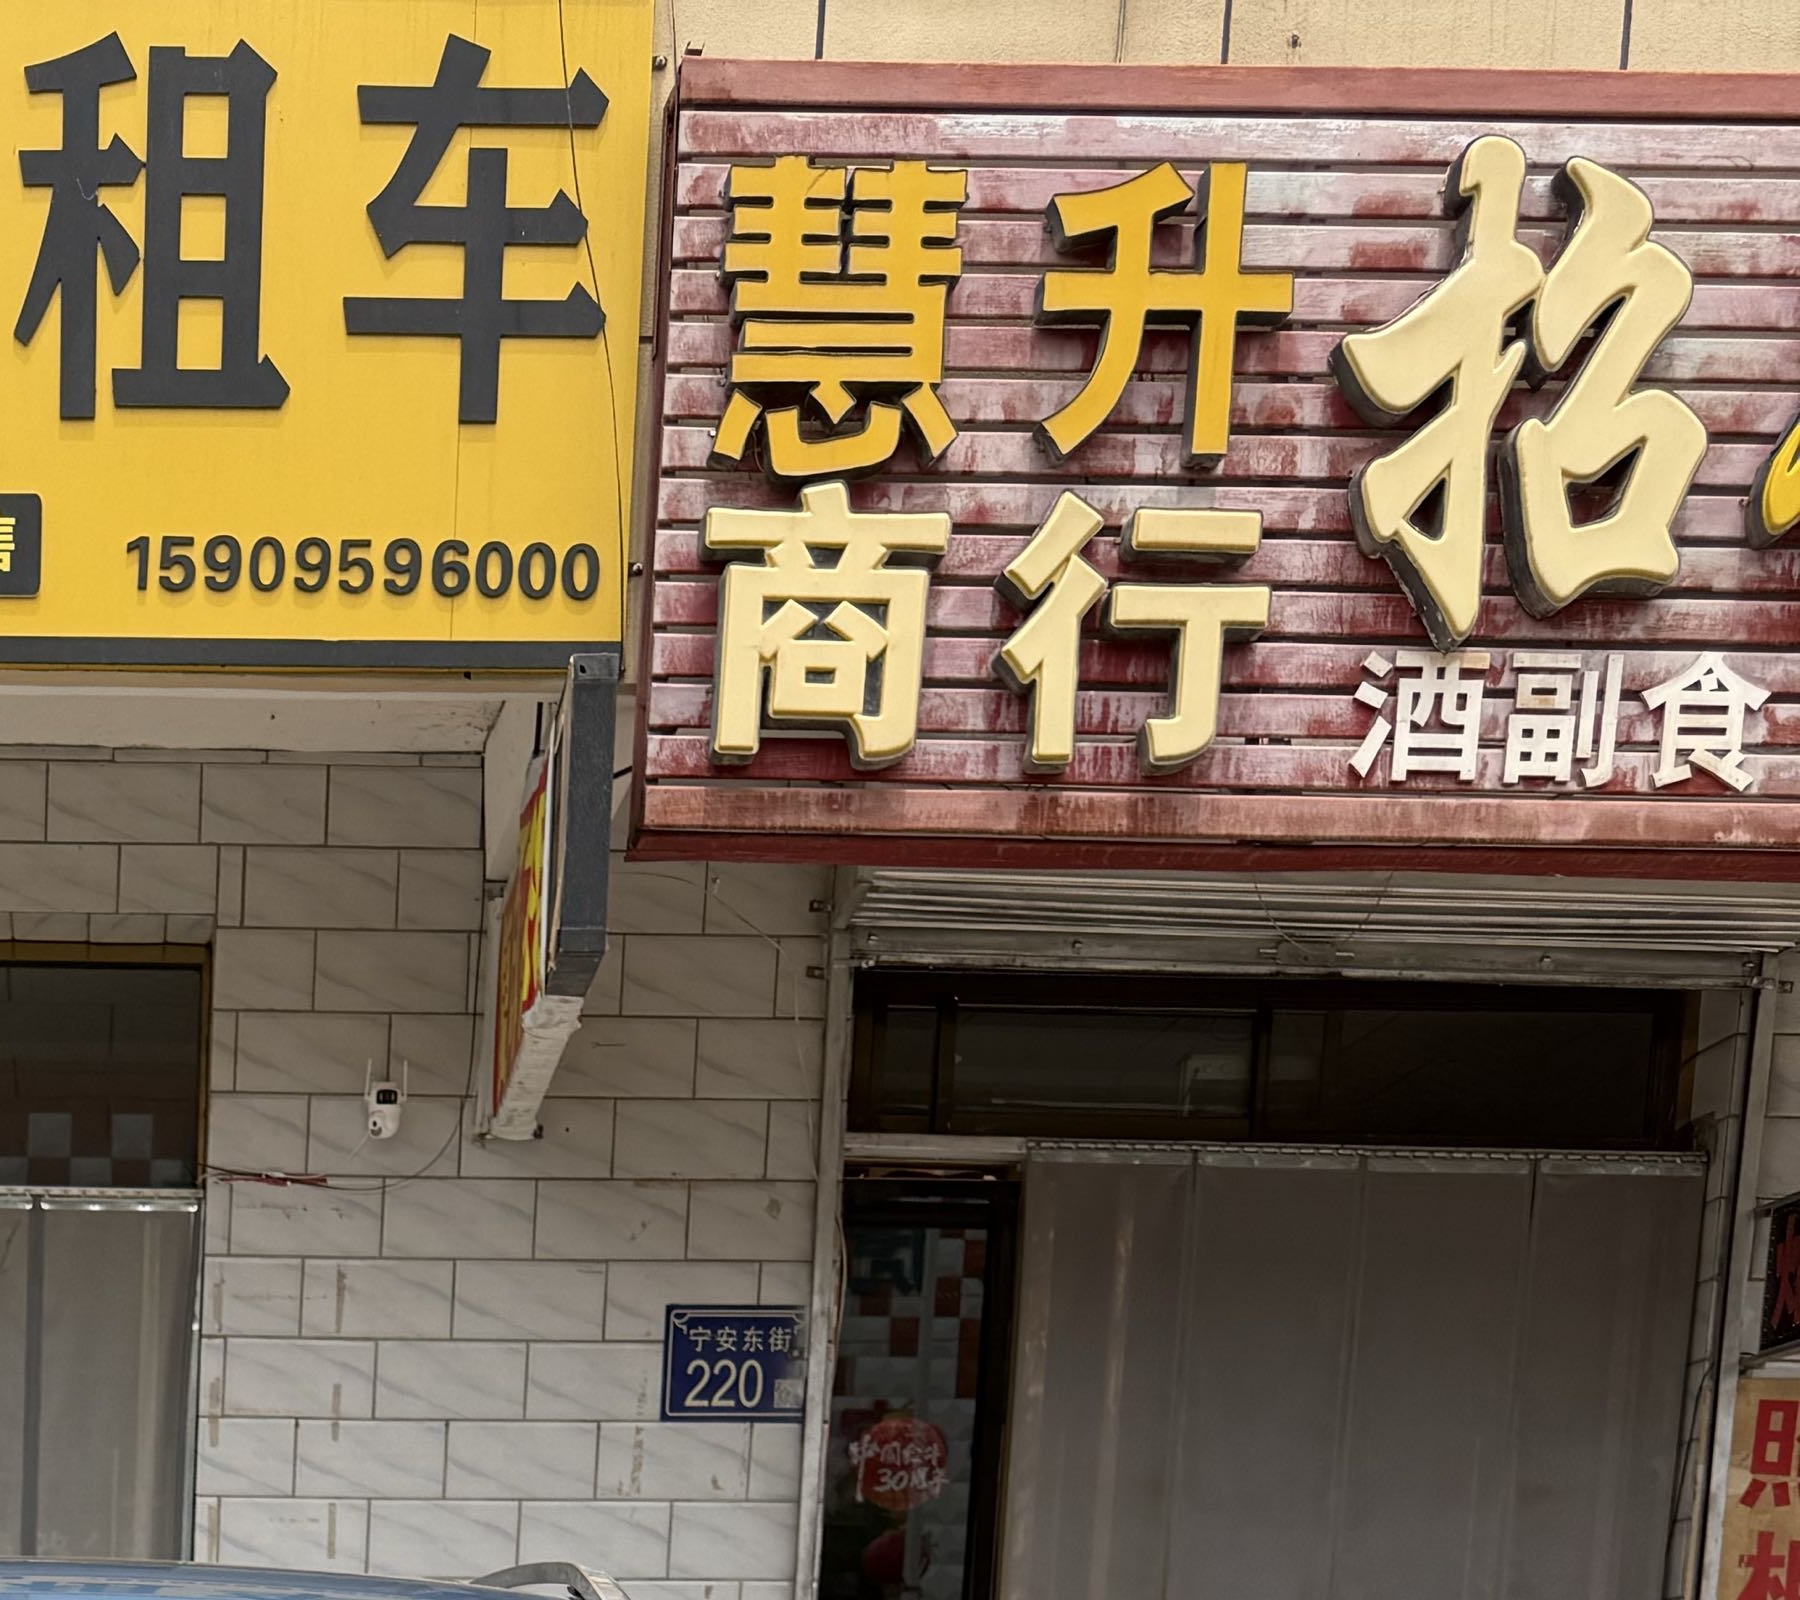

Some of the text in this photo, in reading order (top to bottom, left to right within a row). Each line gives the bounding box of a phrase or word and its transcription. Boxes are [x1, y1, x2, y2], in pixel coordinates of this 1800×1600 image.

[708, 155, 1294, 478] 慧升
[1331, 134, 1800, 650] 招
[125, 534, 600, 602] 15909596000
[700, 480, 1271, 773] 商行
[1350, 651, 1769, 790] 酒副食
[684, 1358, 764, 1409] 220
[688, 1325, 791, 1355] 宁安东街
